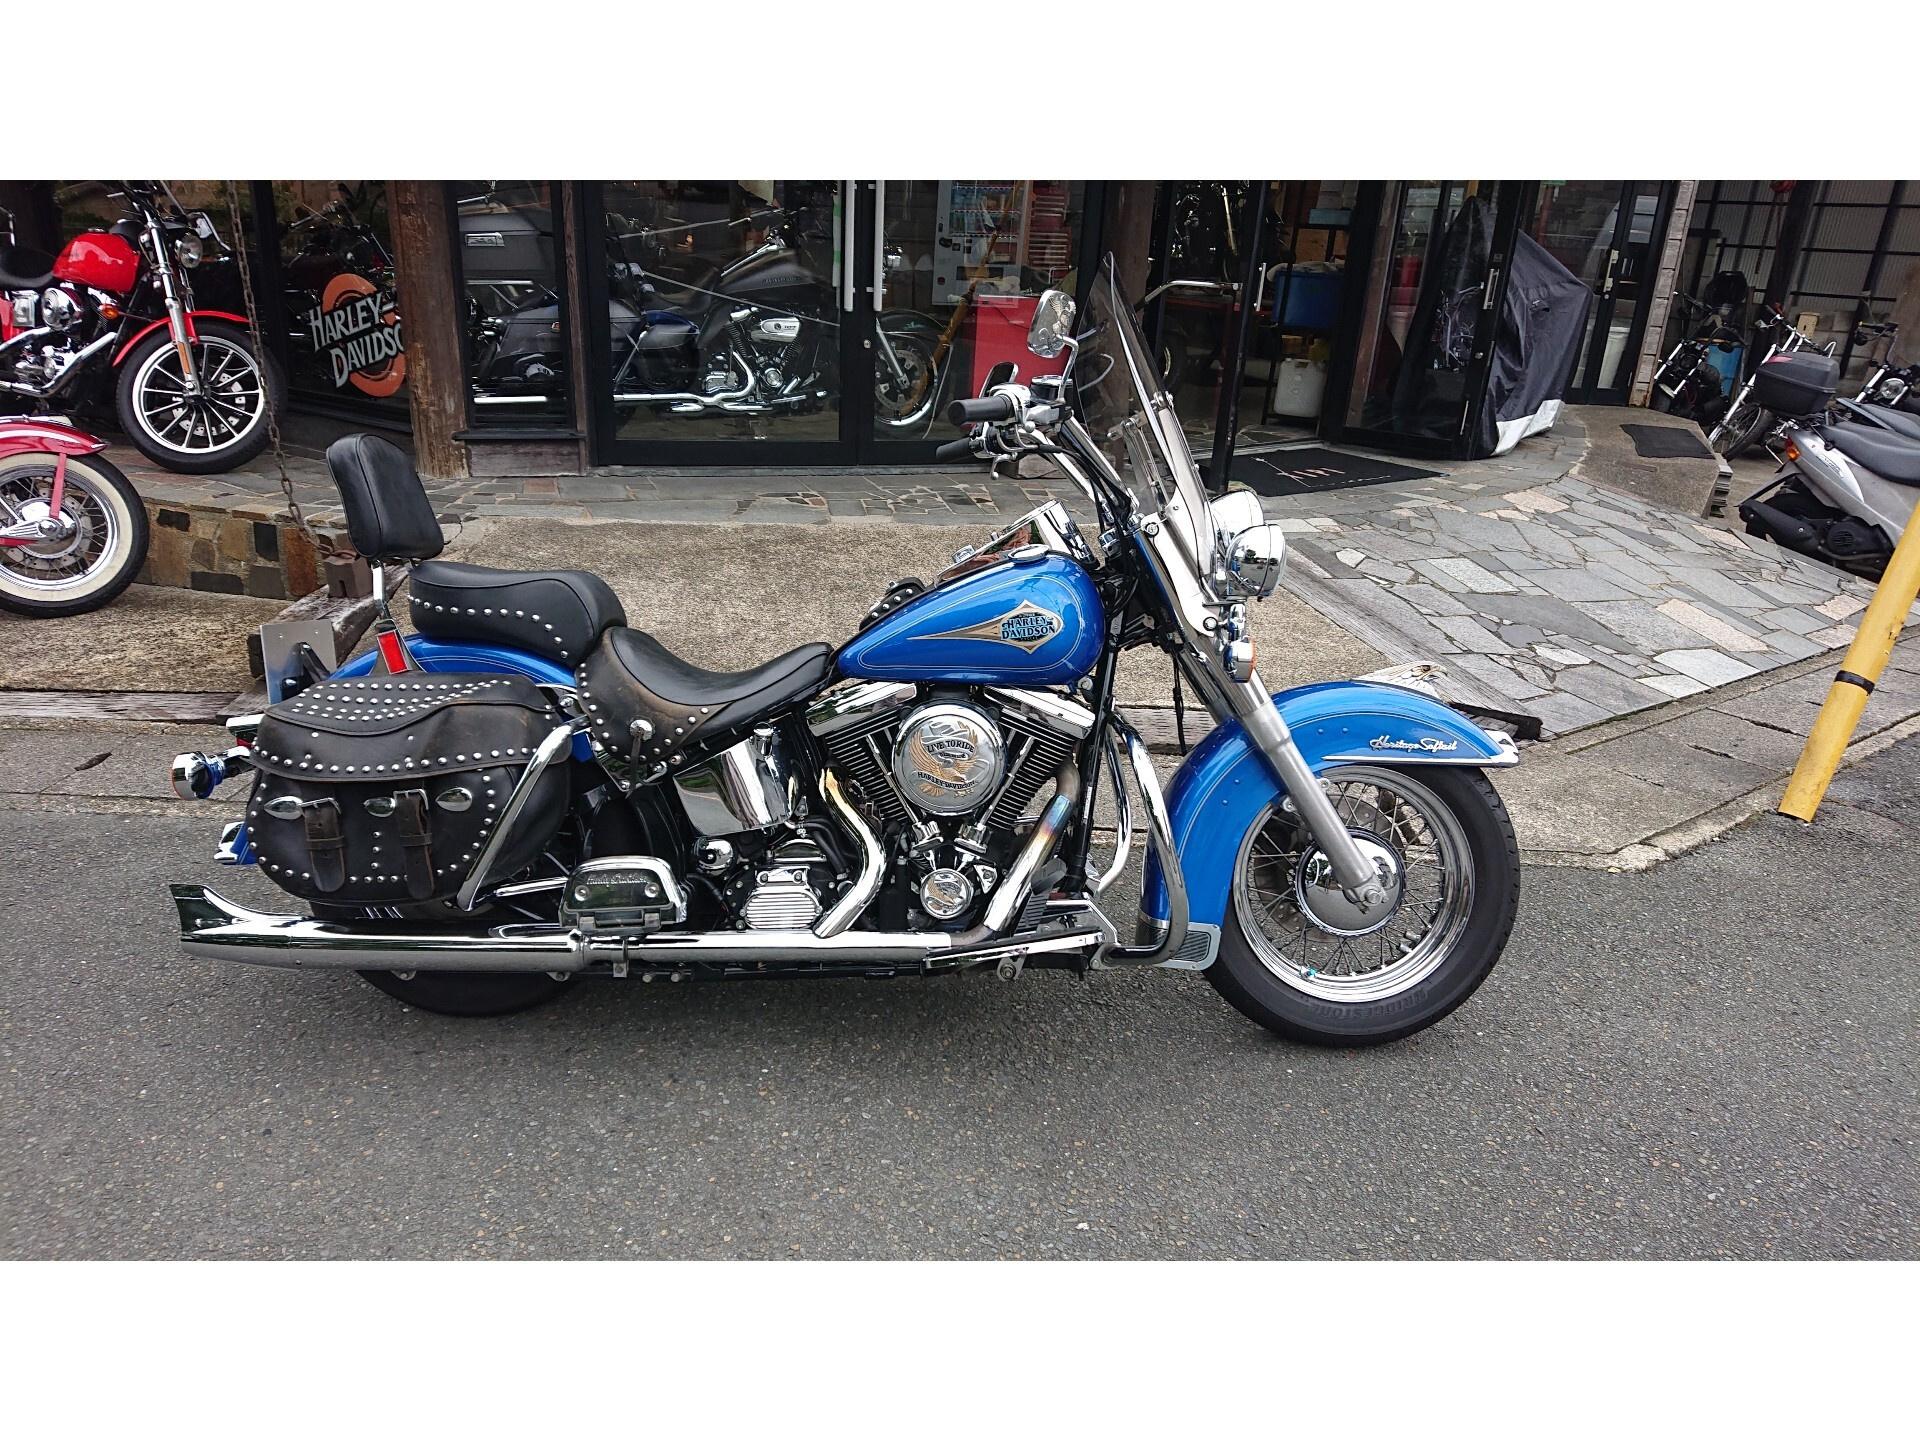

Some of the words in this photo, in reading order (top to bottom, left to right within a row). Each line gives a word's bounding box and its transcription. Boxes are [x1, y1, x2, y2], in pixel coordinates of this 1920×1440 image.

[308, 293, 399, 352] HARLEY-
[1001, 624, 1056, 640] DAVIDSON
[926, 742, 945, 753] LIVE
[1369, 734, 1421, 753] Heritage
[1419, 737, 1458, 753] Softail
